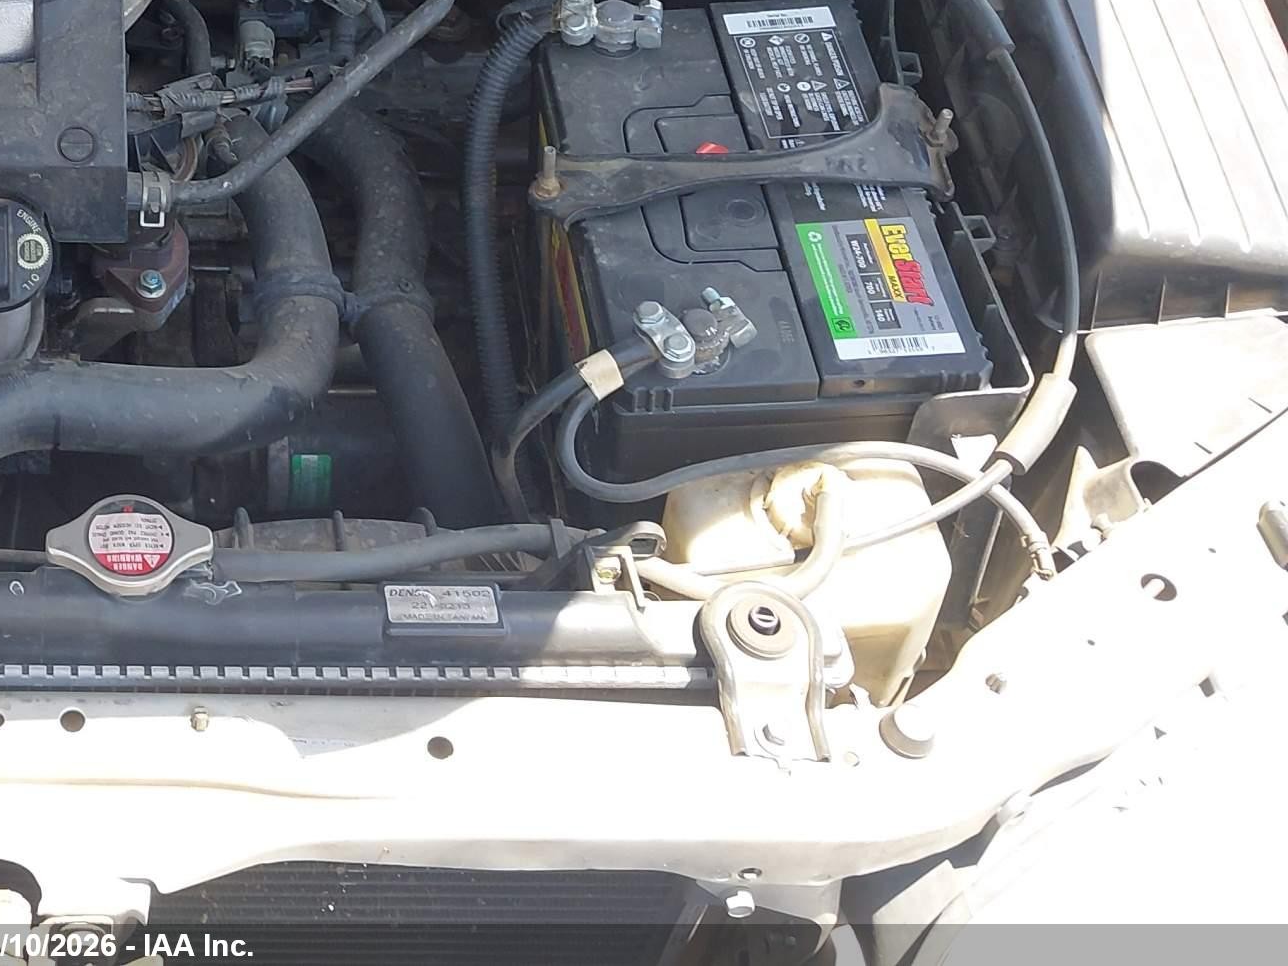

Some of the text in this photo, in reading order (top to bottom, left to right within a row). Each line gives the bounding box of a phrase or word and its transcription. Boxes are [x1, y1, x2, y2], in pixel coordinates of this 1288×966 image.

[16, 208, 42, 234] ENGINE
[879, 224, 935, 306] EverStart
[22, 273, 40, 291] OIL
[863, 281, 876, 295] 700
[886, 275, 904, 299] MAXX
[874, 308, 886, 322] 140
